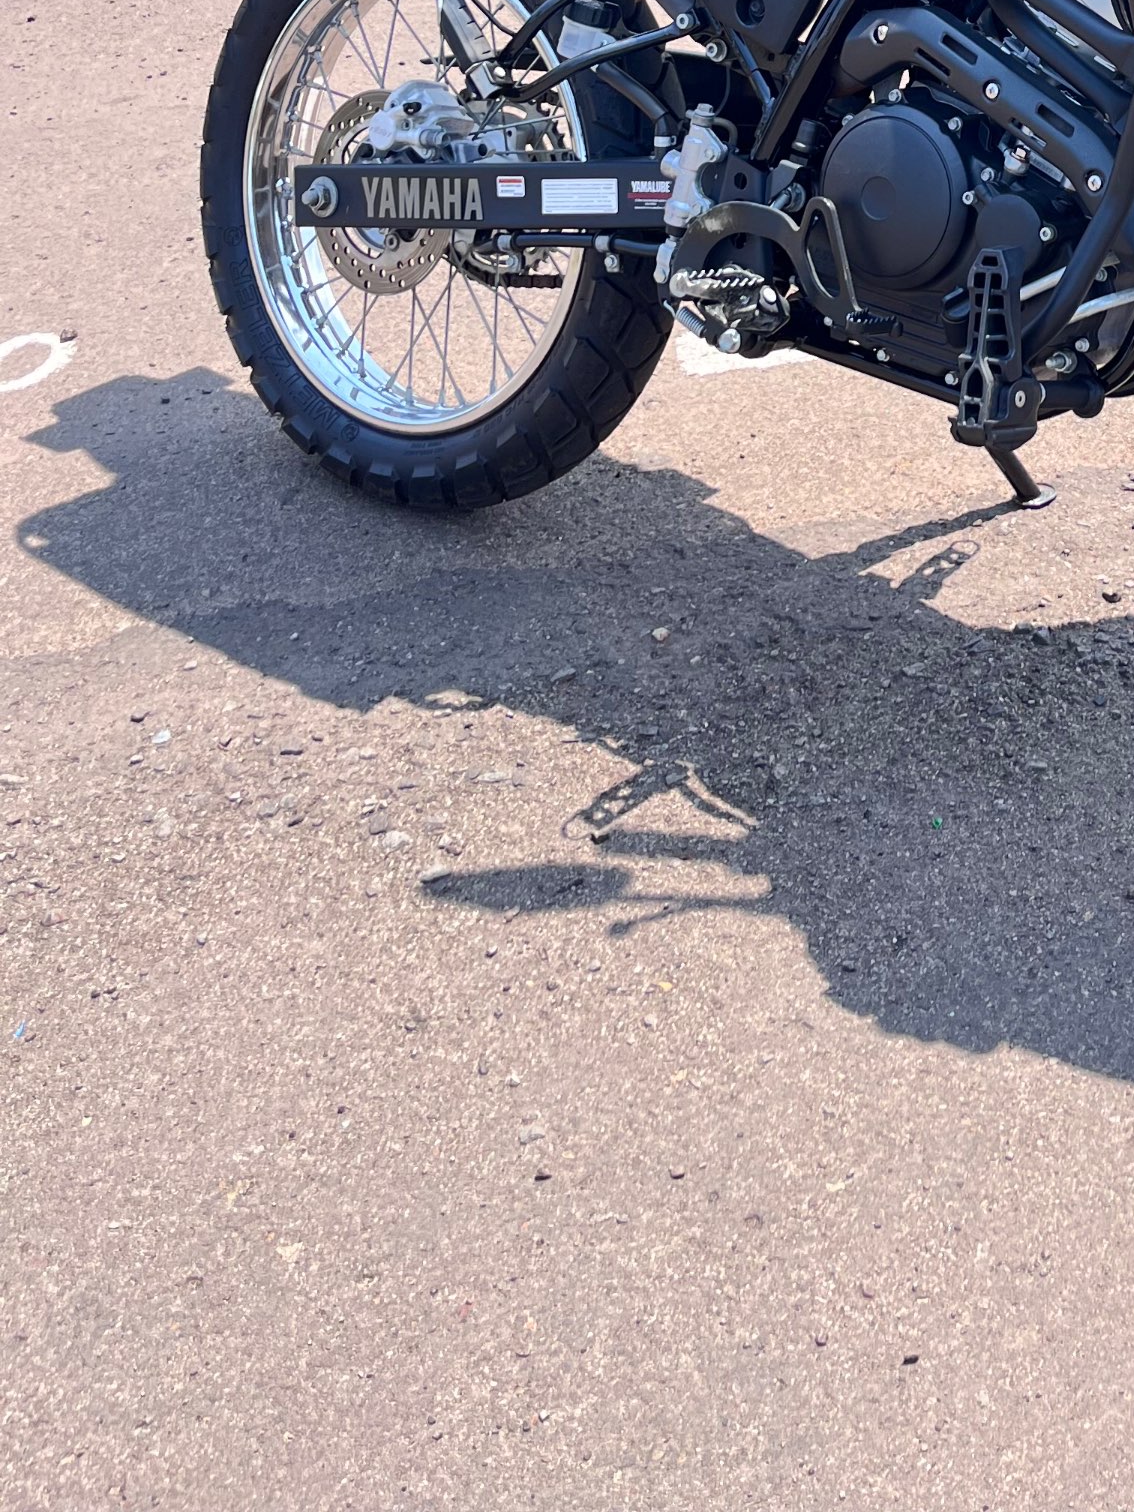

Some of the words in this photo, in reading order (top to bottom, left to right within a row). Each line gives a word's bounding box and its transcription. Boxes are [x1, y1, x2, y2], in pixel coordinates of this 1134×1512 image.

[361, 177, 483, 220] YAMAHA
[631, 181, 671, 192] YAMALUBE
[229, 259, 341, 430] METZELER
